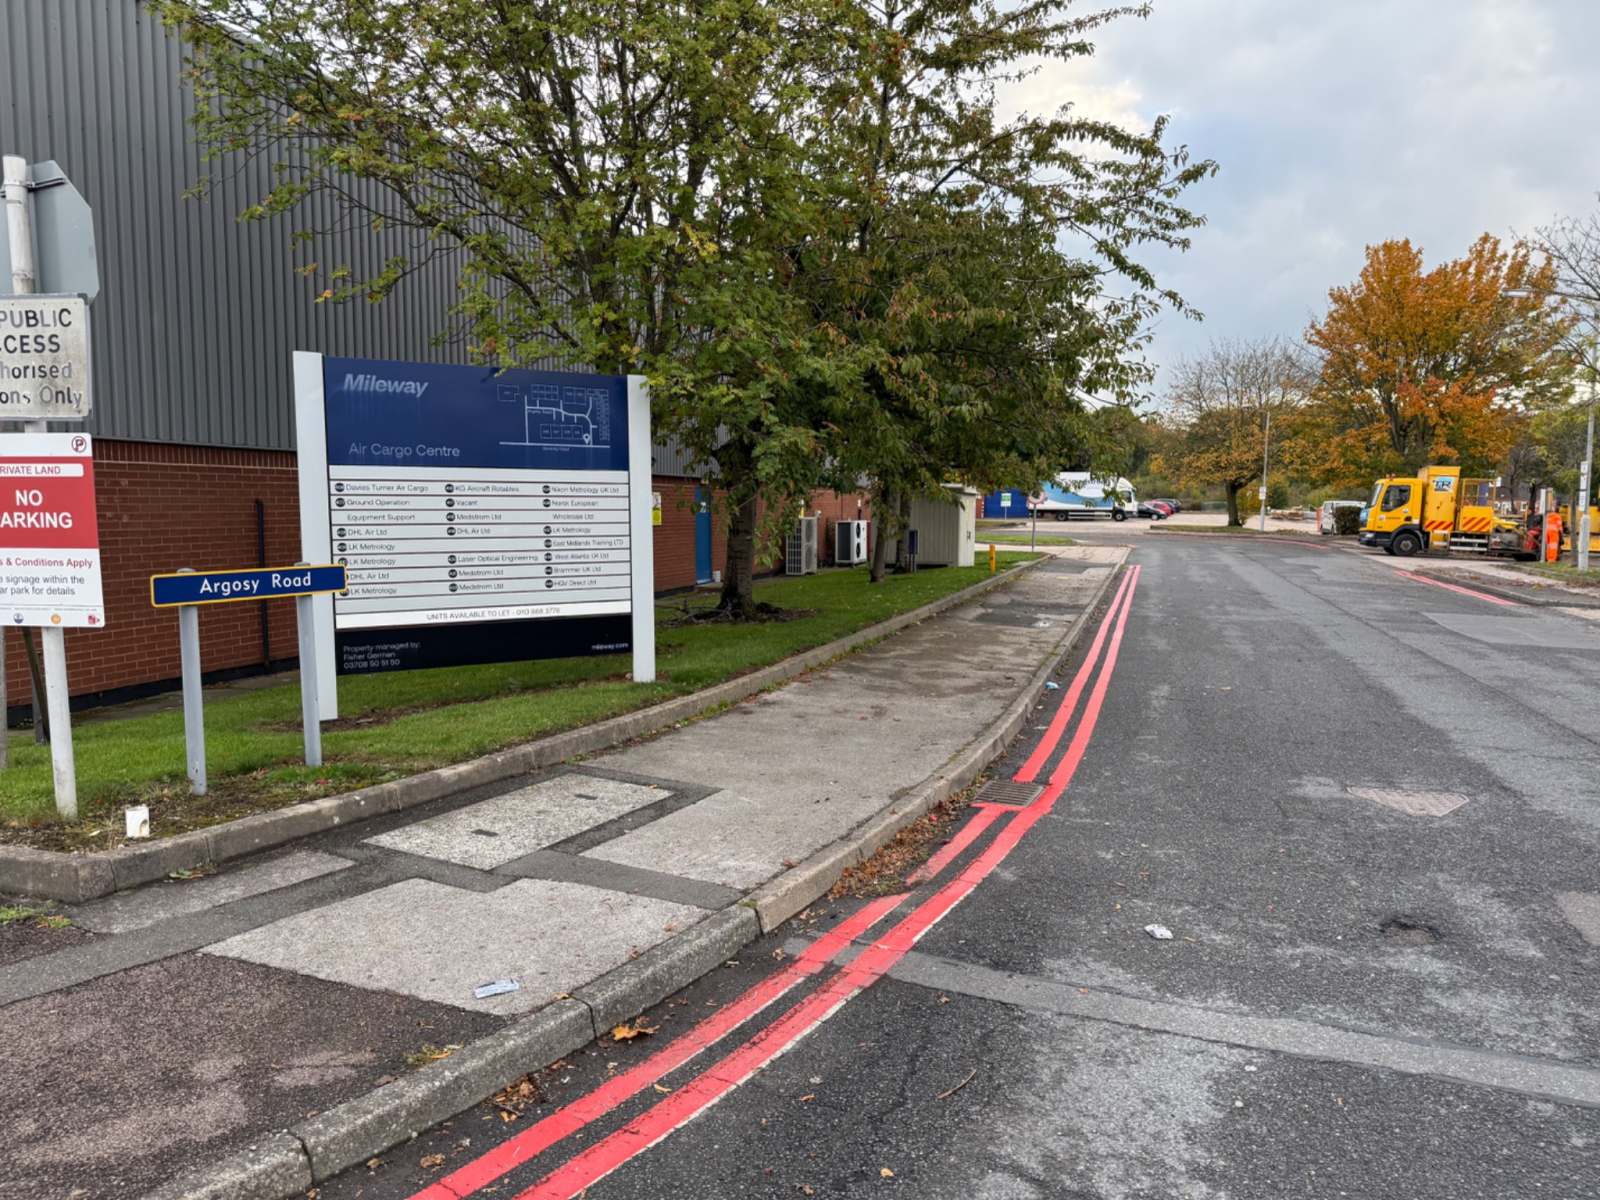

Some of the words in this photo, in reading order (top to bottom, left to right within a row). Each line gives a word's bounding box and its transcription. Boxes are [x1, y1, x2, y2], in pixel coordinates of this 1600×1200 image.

[0, 308, 72, 328] PUBLIC
[0, 334, 61, 354] CESS
[343, 373, 429, 398] Mileway
[40, 386, 82, 408] Only
[349, 443, 367, 456] Air
[370, 443, 413, 458] Cargo
[416, 444, 460, 457] Centre
[35, 465, 61, 475] LAND
[570, 486, 598, 494] Metrology
[16, 489, 43, 507] NO
[375, 499, 410, 507] Operation
[0, 511, 73, 529] ARKING
[347, 514, 385, 522] Equipment
[387, 514, 416, 522] Support
[360, 543, 395, 551] Metrology
[6, 558, 12, 566] &
[15, 557, 64, 567] Conditions
[66, 558, 93, 569] Apply
[477, 555, 500, 563] Optical
[502, 554, 539, 562] Engineering
[6, 577, 40, 586] signage
[42, 576, 68, 584] within
[70, 576, 85, 585] the
[199, 578, 260, 596] Argosy
[271, 572, 311, 588] Road
[11, 586, 30, 596] park
[32, 586, 43, 594] for
[46, 587, 76, 596] details
[361, 587, 397, 595] Metrology
[449, 610, 485, 619] AVAILABLE
[487, 609, 497, 617] TO
[498, 609, 511, 617] LET
[344, 645, 374, 654] Property
[376, 642, 409, 650] managed
